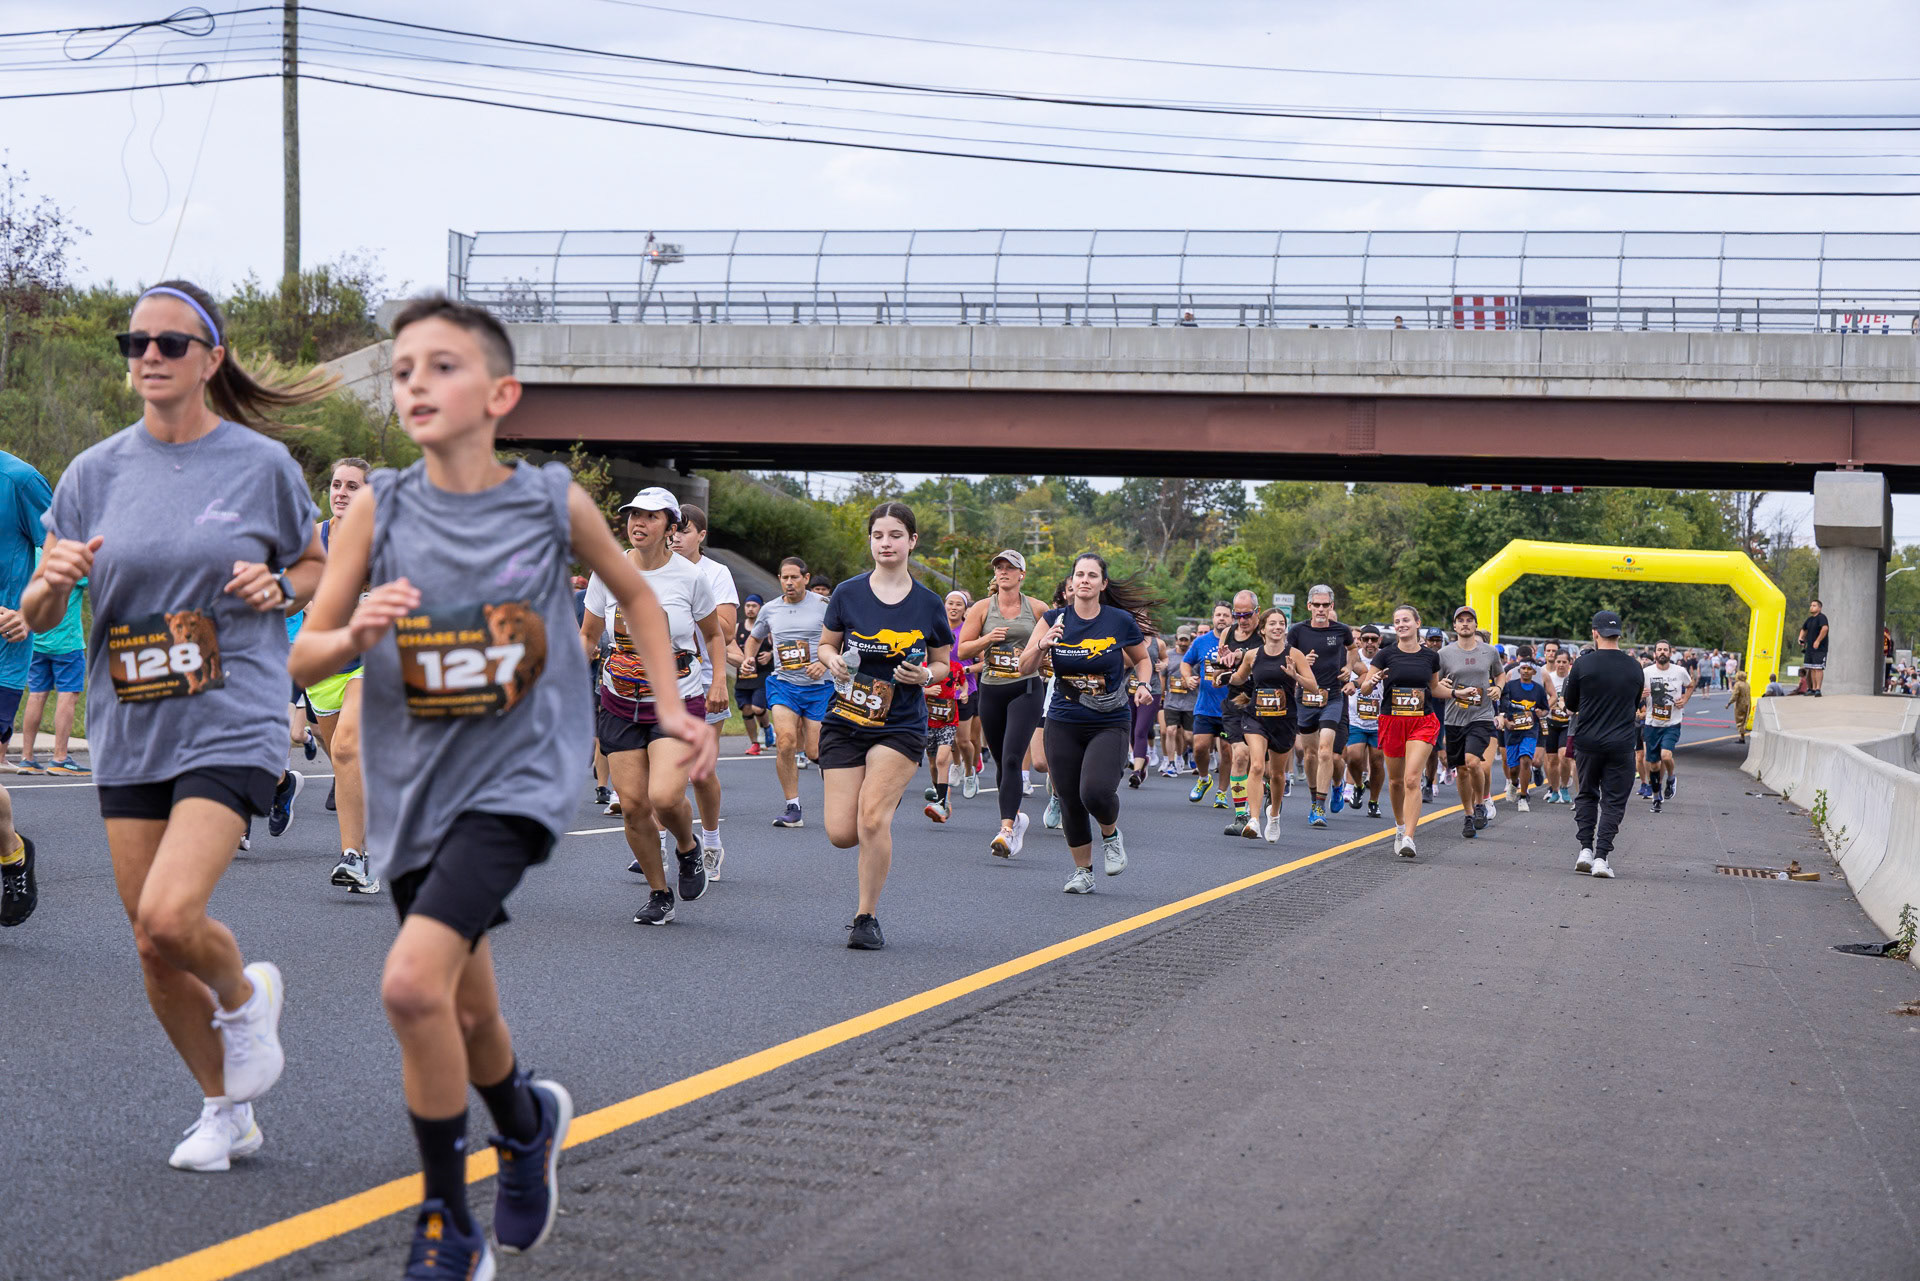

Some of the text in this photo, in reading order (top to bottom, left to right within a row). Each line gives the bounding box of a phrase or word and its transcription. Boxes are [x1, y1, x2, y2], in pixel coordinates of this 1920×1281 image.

[396, 615, 431, 629] THE
[109, 625, 130, 635] THE
[109, 632, 169, 649] CHASE 5K
[396, 631, 457, 648] CHASE
[859, 642, 888, 650] CHASE
[781, 648, 805, 660] 391
[120, 642, 203, 682] 128
[416, 643, 526, 690] 127
[844, 686, 882, 710] 193
[1262, 698, 1280, 706] 171
[1307, 694, 1323, 702] 112
[1396, 697, 1419, 705] 170
[932, 706, 951, 716] 117
[1359, 704, 1377, 712] 281
[1515, 717, 1532, 725] 274
